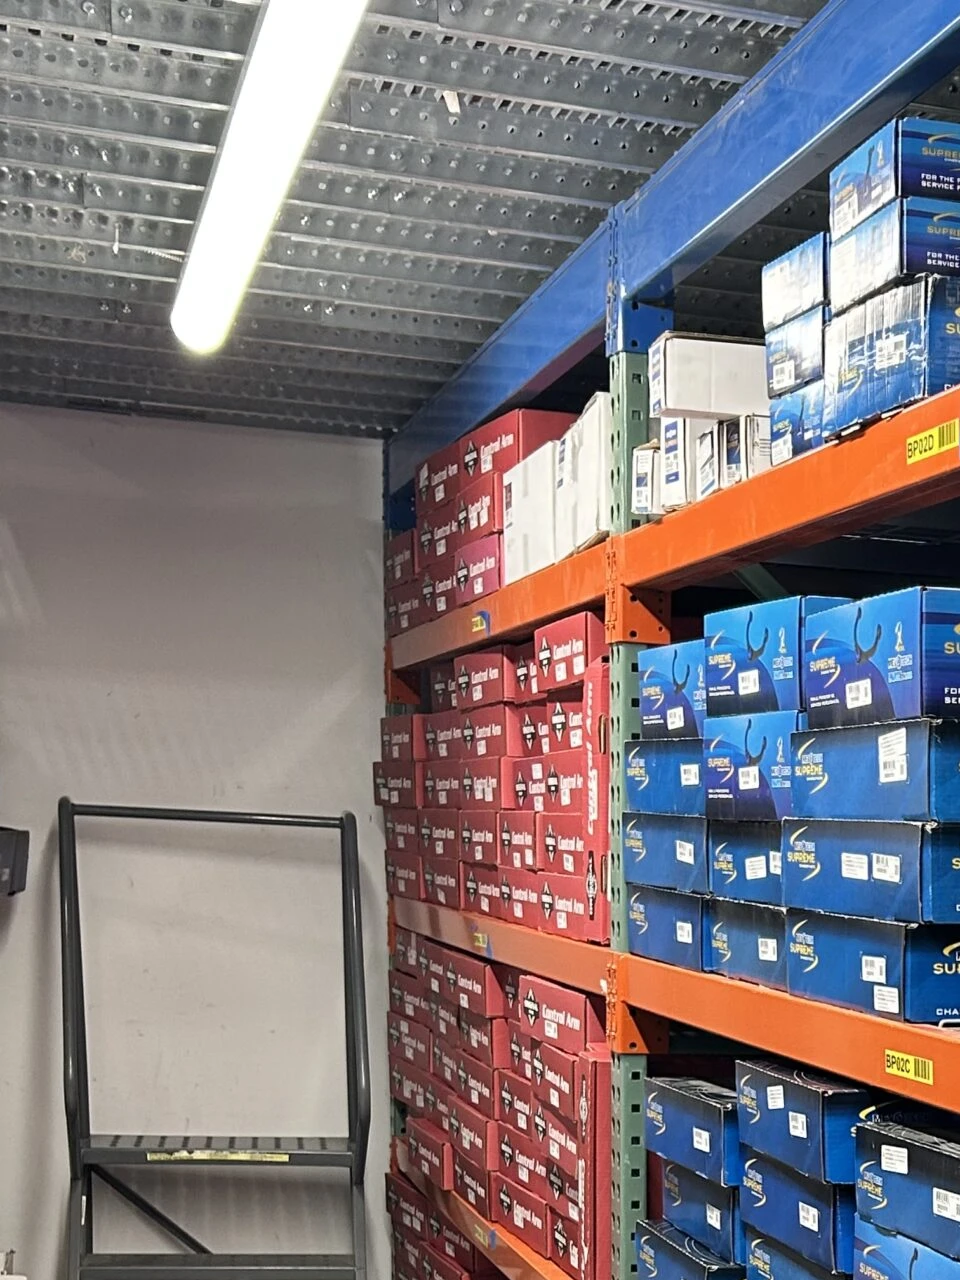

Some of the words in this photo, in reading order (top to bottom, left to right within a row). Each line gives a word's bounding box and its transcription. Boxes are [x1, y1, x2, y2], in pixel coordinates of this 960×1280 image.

[939, 175, 954, 183] THE
[907, 434, 934, 459] BP02D
[708, 653, 733, 667] SUPREME
[809, 656, 836, 672] SUPREME
[945, 687, 960, 695] FOR
[795, 763, 824, 776] SUPREME
[787, 851, 815, 864] SUPREME
[789, 942, 815, 955] SUPREME
[542, 1004, 564, 1026] Control
[565, 1012, 580, 1031] Arm
[886, 1052, 910, 1074] BP02C
[857, 1179, 883, 1197] SUPREME
